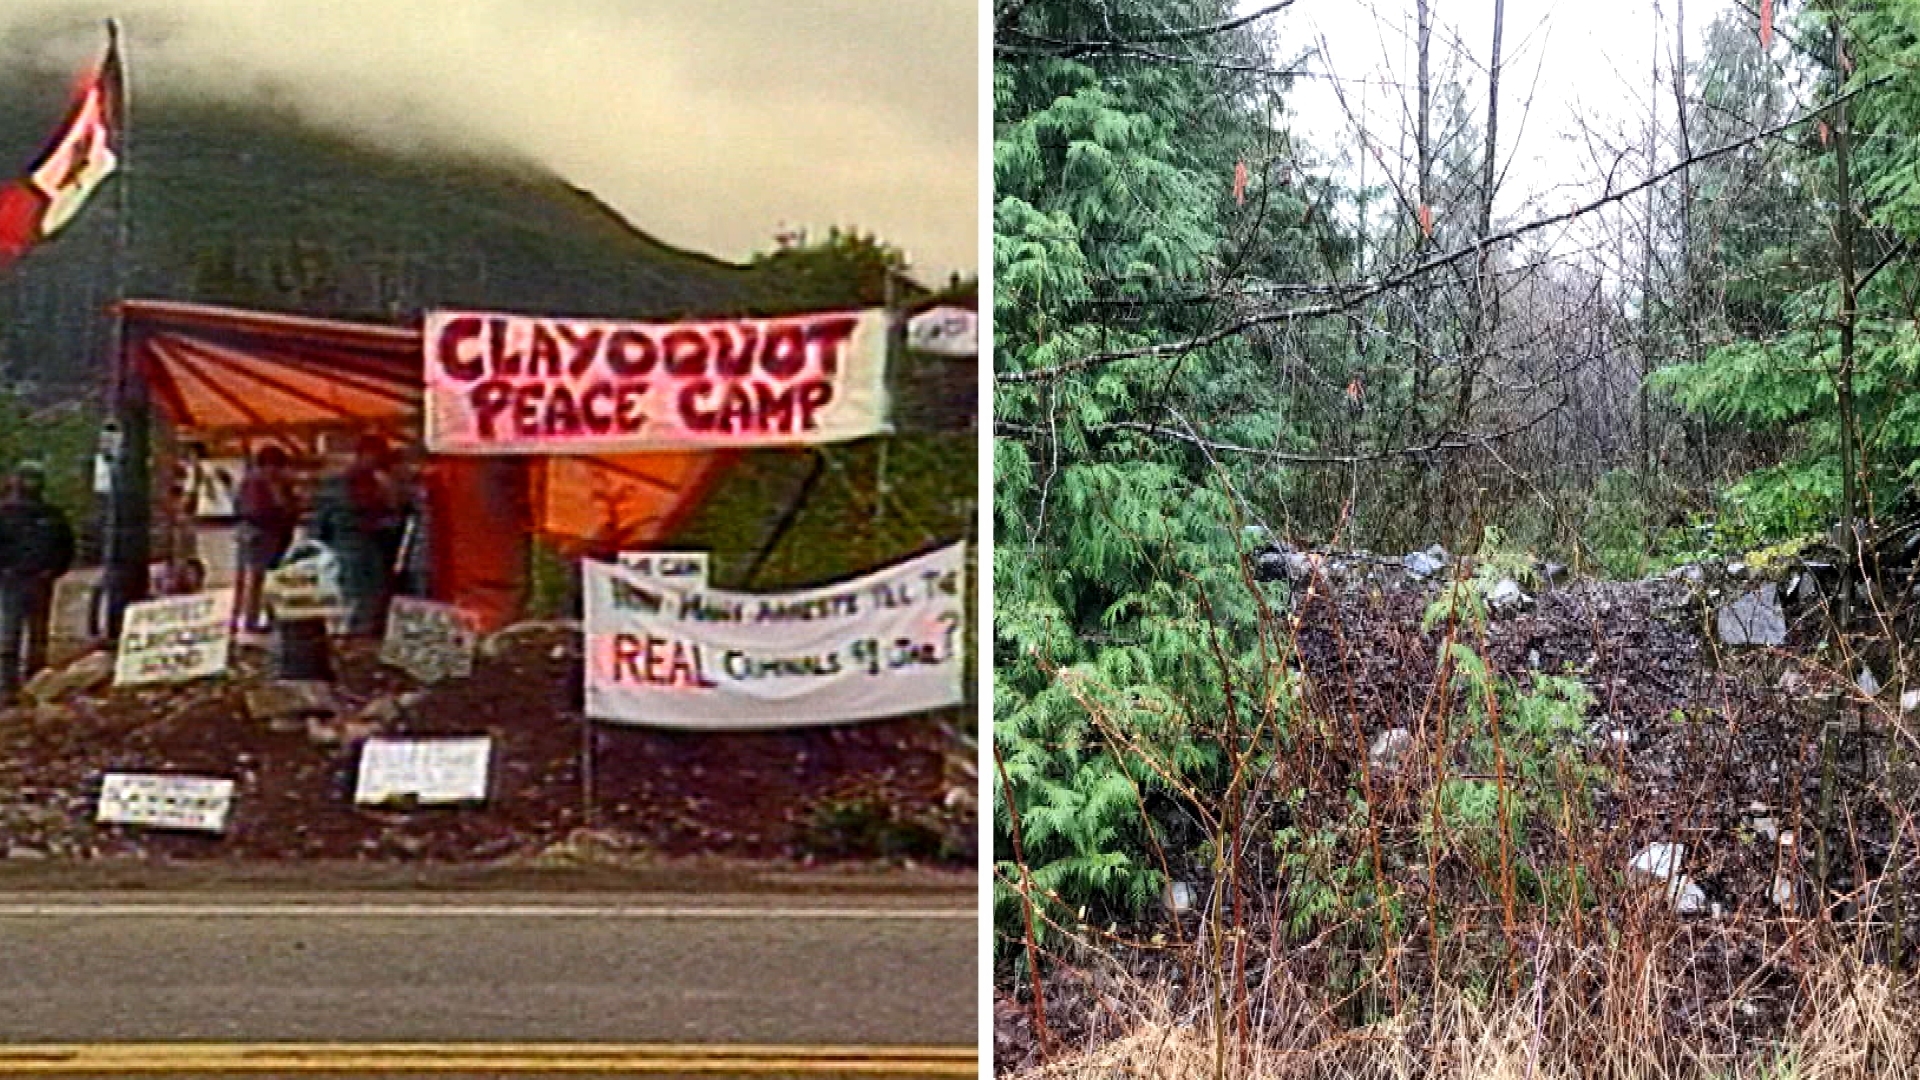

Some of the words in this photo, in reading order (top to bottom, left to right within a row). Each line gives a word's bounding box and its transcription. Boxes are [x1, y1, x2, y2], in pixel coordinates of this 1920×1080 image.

[438, 317, 858, 380] CLAYOQUOT
[470, 381, 649, 440] PEACE
[678, 381, 833, 432] CAMP
[613, 633, 718, 688] REAL
